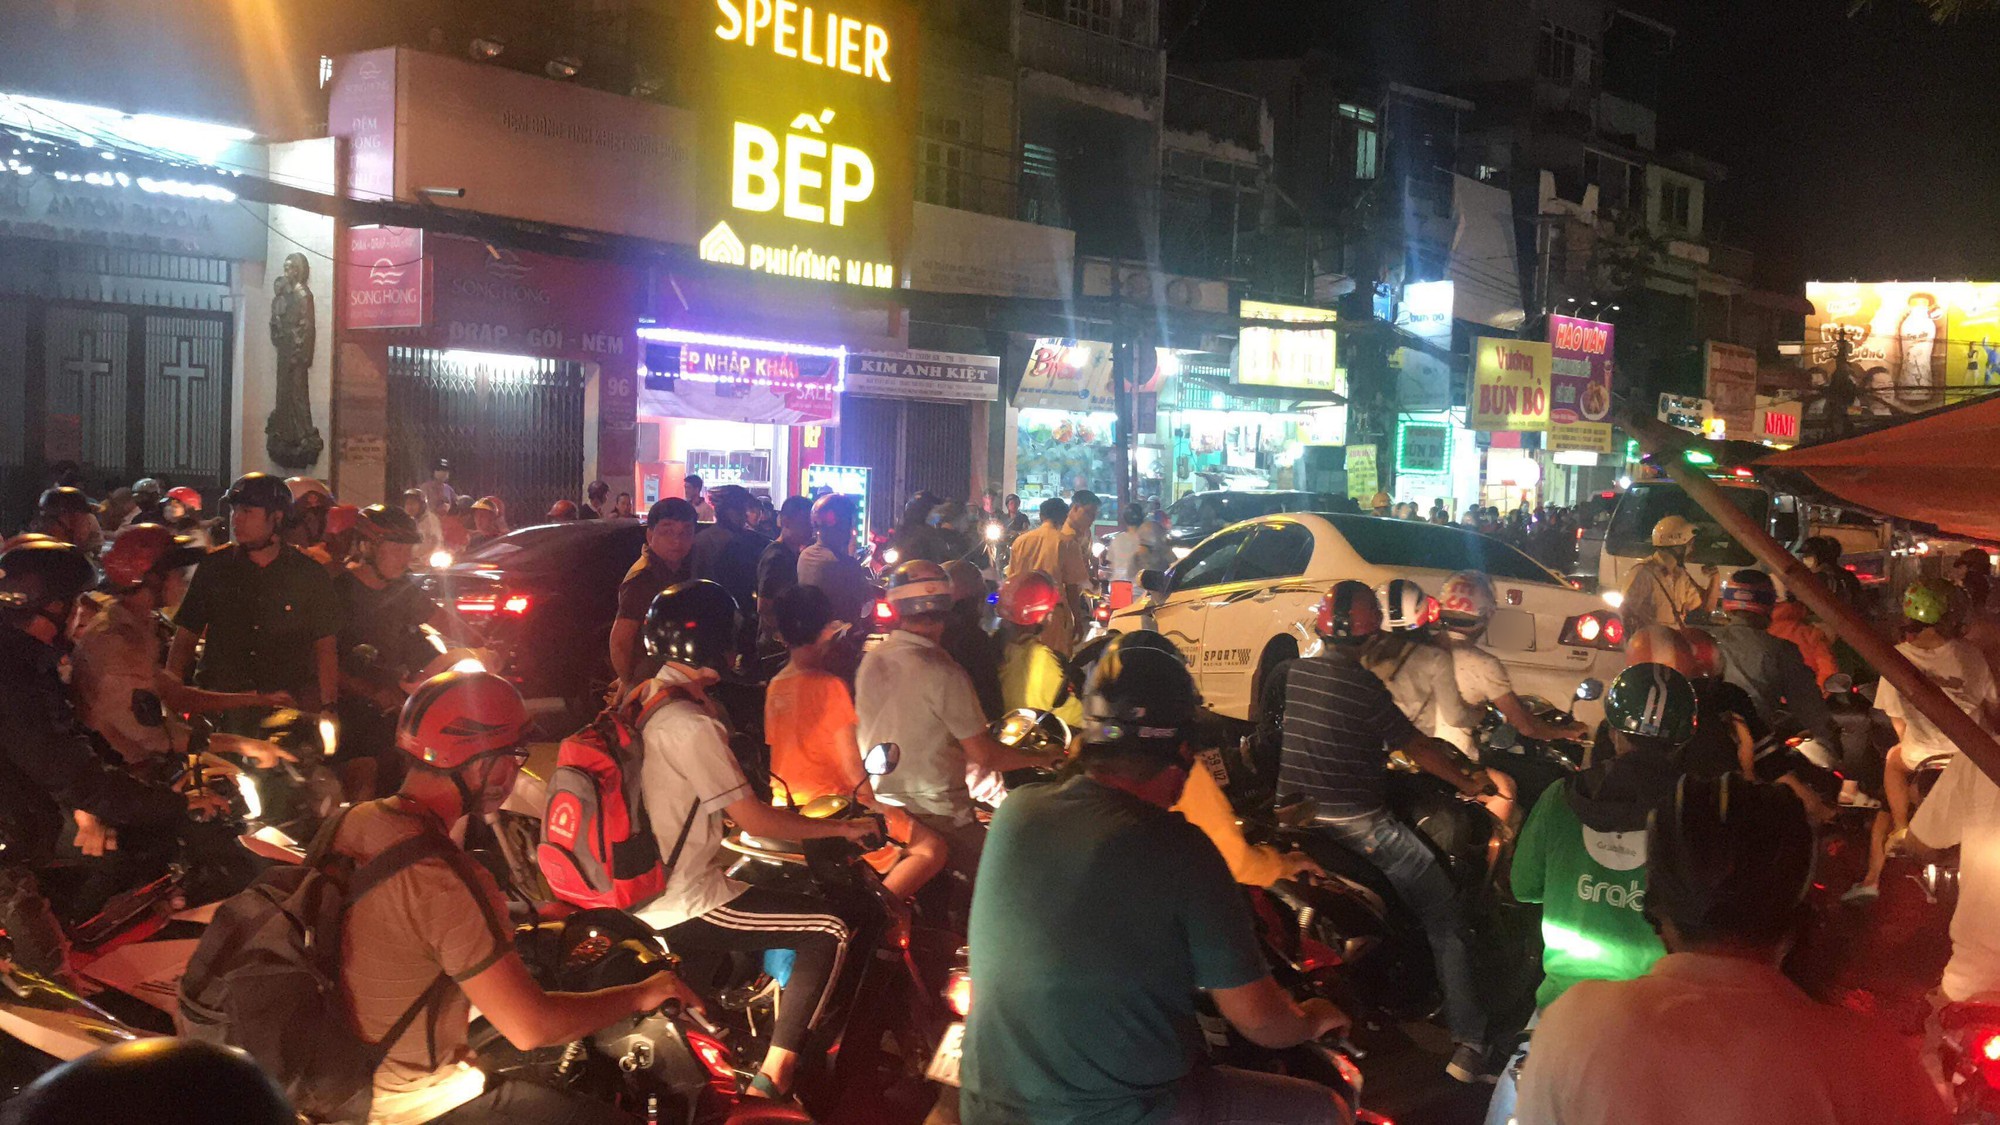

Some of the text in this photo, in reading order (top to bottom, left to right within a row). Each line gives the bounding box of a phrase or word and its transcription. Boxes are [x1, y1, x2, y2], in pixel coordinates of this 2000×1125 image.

[715, 0, 892, 83] SPELIER
[732, 108, 875, 227] BẾP
[846, 259, 893, 289] NAM
[607, 376, 630, 397] 96
[860, 360, 989, 382] KIM ANH KIỆT
[1478, 375, 1518, 415] BÚN
[1522, 377, 1546, 416] BÒ
[1203, 649, 1237, 662] SPORT
[1577, 873, 1647, 912] Grab
